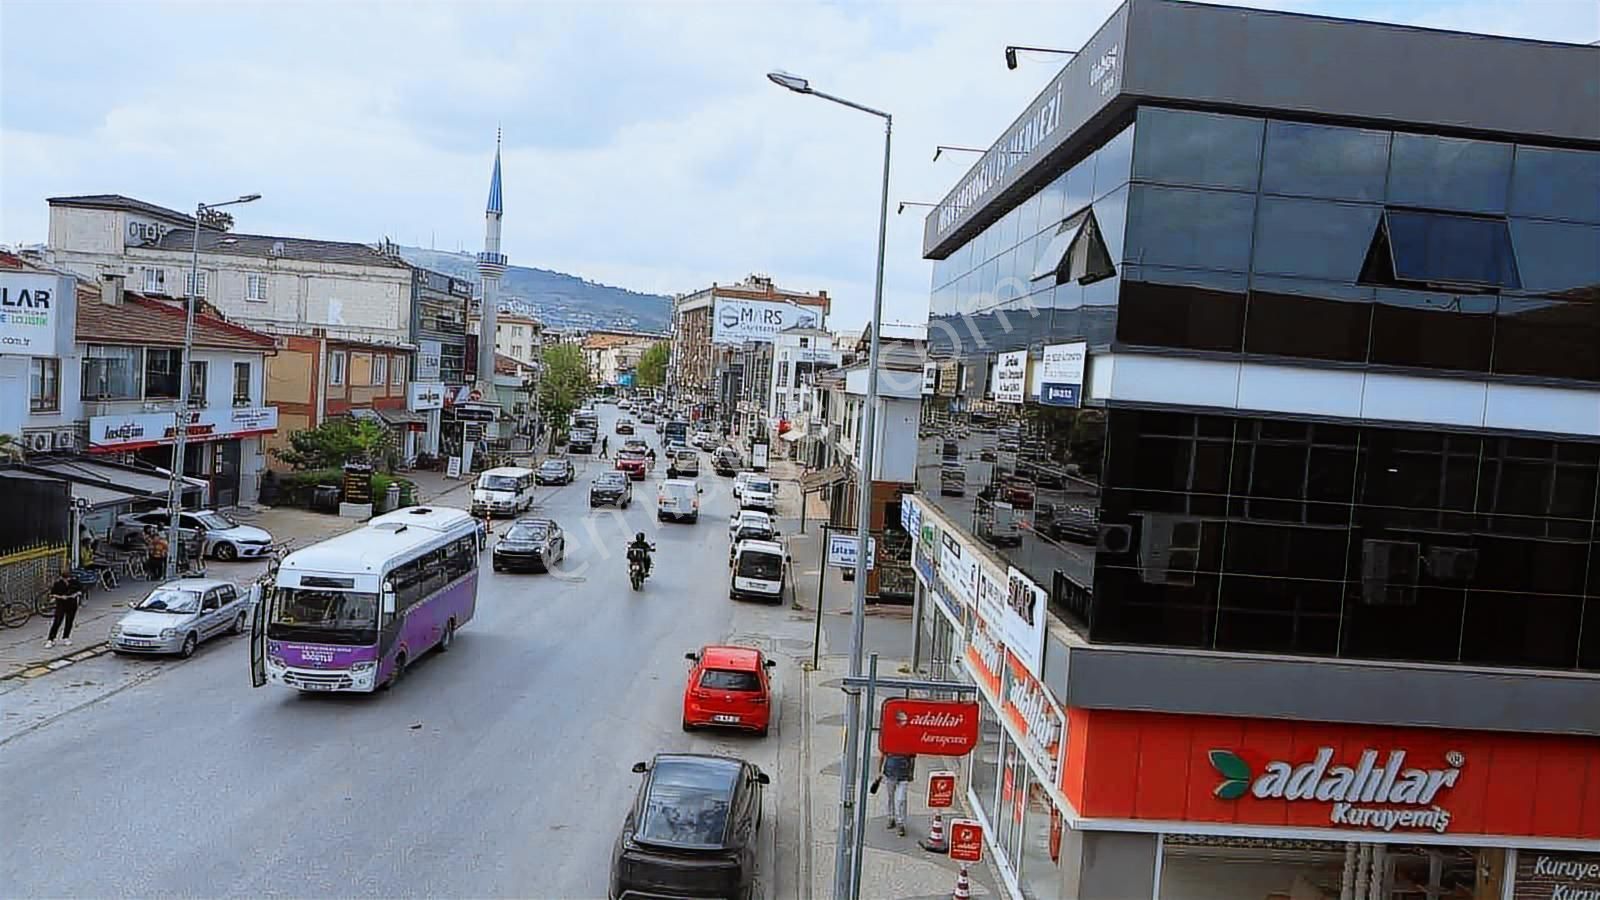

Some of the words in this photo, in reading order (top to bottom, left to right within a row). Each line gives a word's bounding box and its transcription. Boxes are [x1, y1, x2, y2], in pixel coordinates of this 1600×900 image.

[0, 287, 50, 309] LAR
[741, 307, 783, 325] MARS
[1252, 746, 1461, 804] adalılar
[1330, 801, 1450, 833] Kuruyemiş
[1534, 856, 1600, 880] Kuruye
